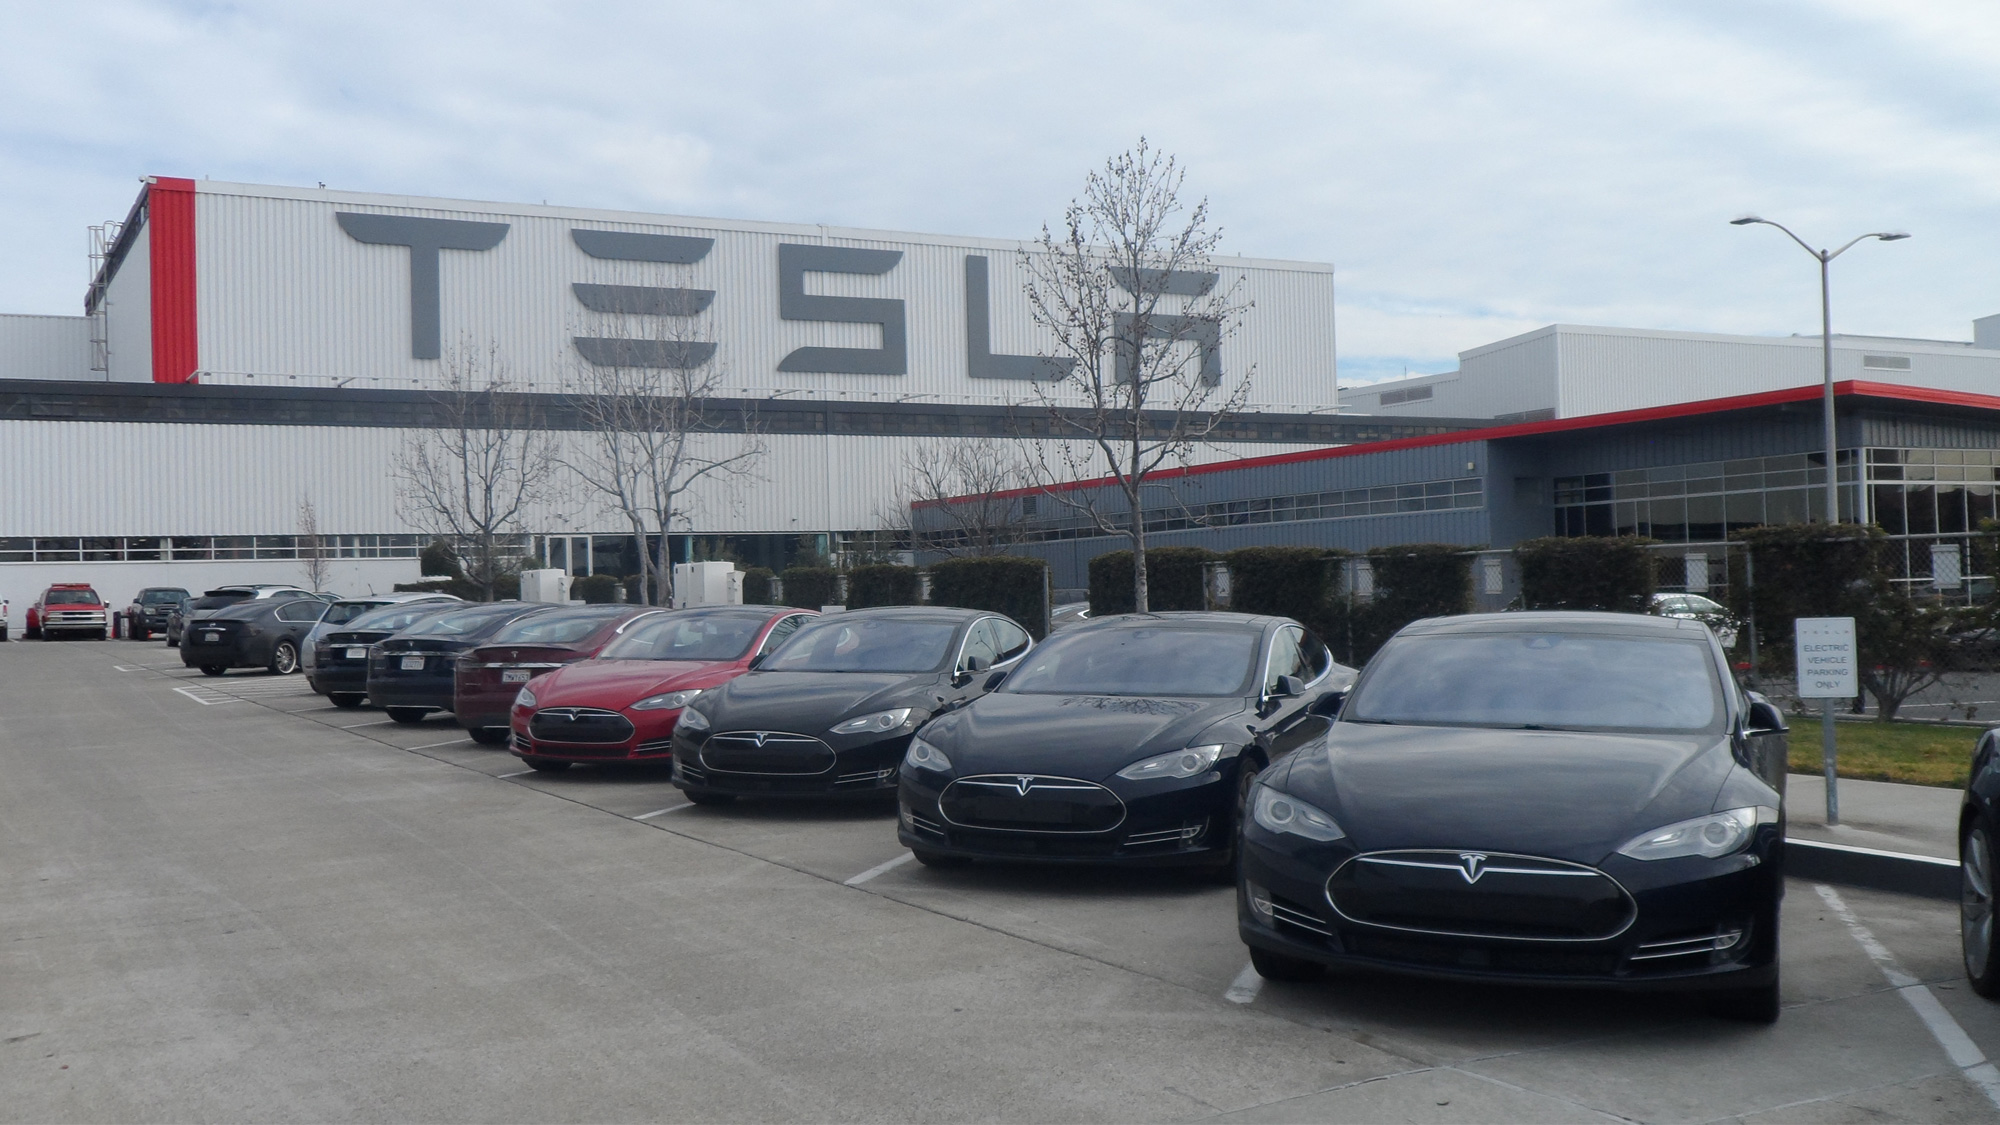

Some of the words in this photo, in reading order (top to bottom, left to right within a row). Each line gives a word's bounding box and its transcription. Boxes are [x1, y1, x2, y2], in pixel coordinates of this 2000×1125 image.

[336, 212, 1221, 387] TESLA
[1803, 644, 1849, 652] ELECTRIC
[1807, 656, 1847, 664] VEHICLE
[1807, 668, 1848, 676] PARKING
[1815, 681, 1840, 689] ONLY
